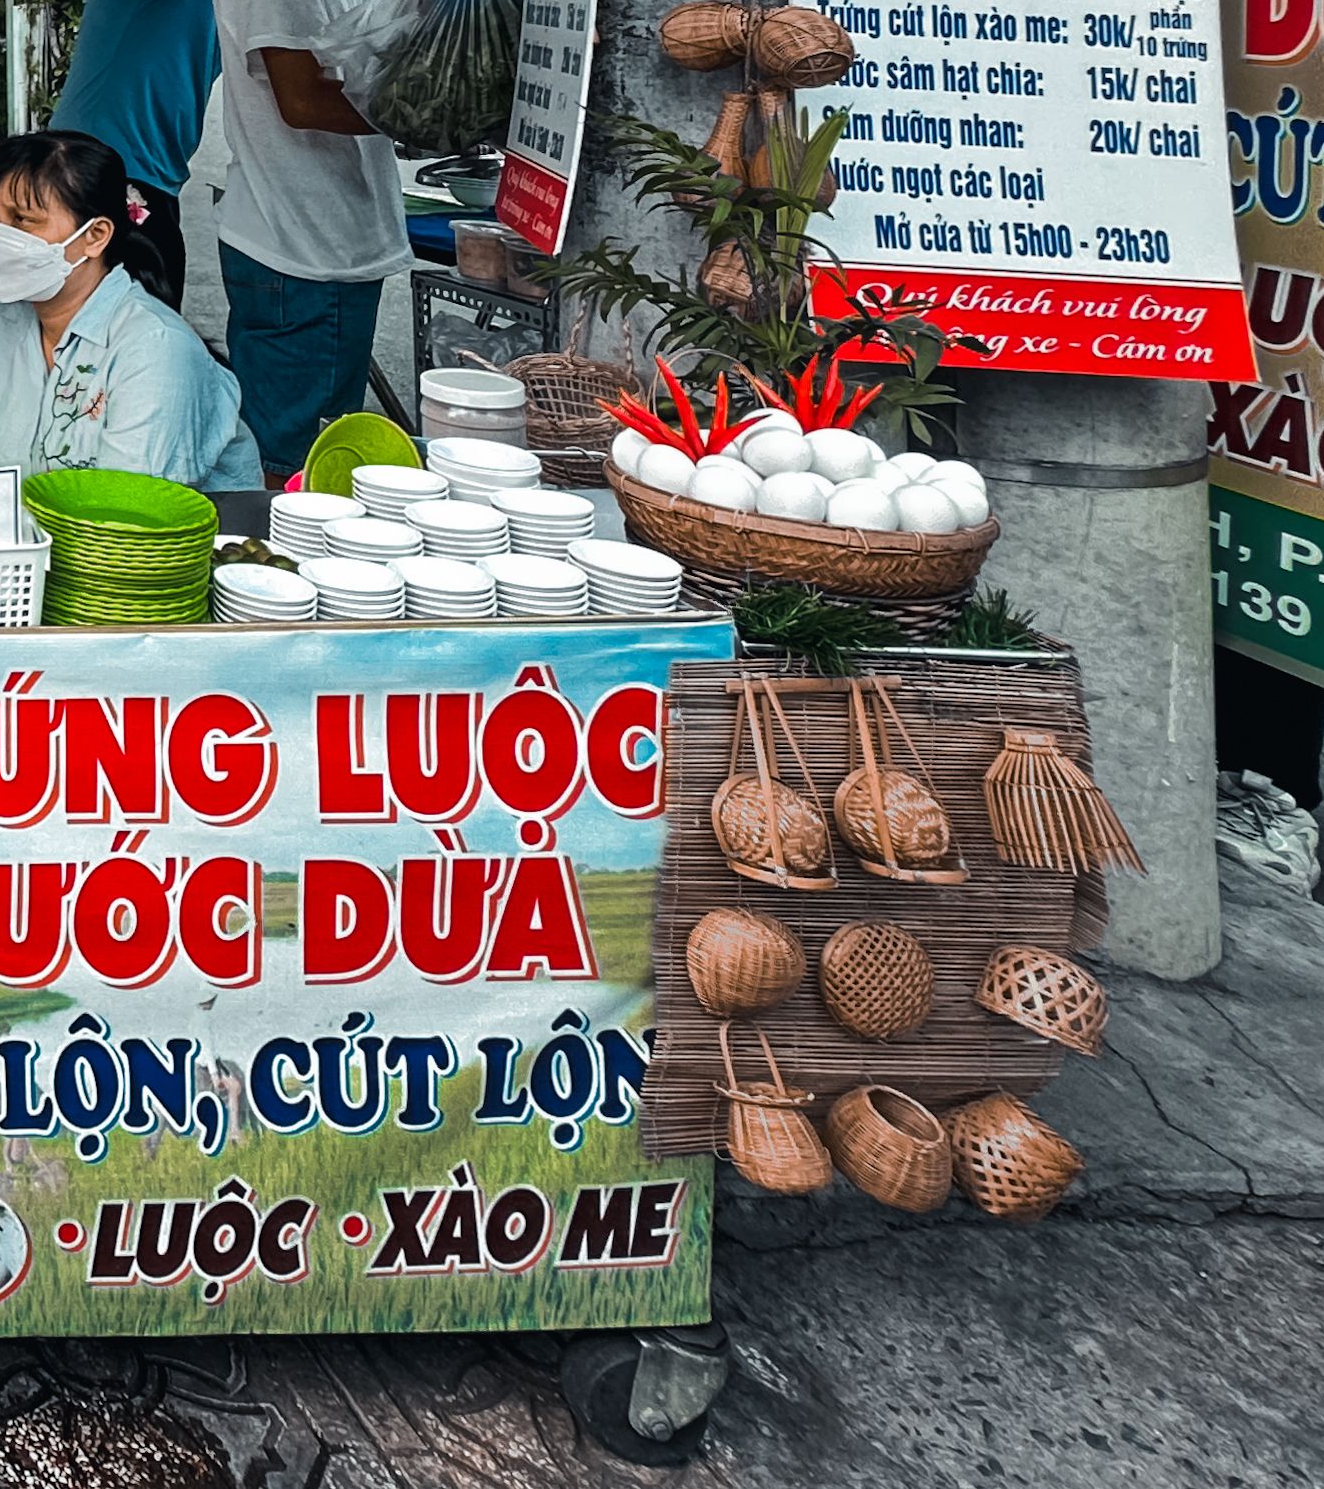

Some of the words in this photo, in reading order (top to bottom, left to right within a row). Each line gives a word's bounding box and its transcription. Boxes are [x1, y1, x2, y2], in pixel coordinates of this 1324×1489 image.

[816, 0, 881, 39] Trứng
[888, 1, 925, 37] cút
[931, 2, 968, 46] lộn
[976, 7, 1017, 43] xào
[1025, 14, 1068, 45] me:
[1084, 13, 1136, 49] 30k/
[1149, 5, 1193, 31] phần
[1136, 35, 1157, 57] 10
[1162, 35, 1208, 62] trứng
[887, 56, 935, 91] sâm
[943, 59, 979, 101] hạt
[987, 61, 1044, 97] chia:
[1087, 67, 1138, 102] 15k/
[1146, 69, 1196, 105] chai
[882, 109, 952, 150] dưỡng
[960, 114, 1024, 148] nhan:
[1090, 120, 1141, 155] 20k/
[1149, 121, 1201, 159] chai
[892, 164, 943, 203] ngọt
[950, 163, 992, 199] các
[1000, 166, 1045, 209] loại
[874, 212, 911, 251] Mở
[919, 214, 961, 253] cửa
[968, 216, 992, 255] từ
[999, 222, 1072, 259] 15h00
[1097, 227, 1171, 264] 23h30
[946, 283, 1052, 316] khách
[1063, 299, 1119, 319] vui
[1128, 293, 1208, 335] lòng
[1018, 336, 1060, 355] xe
[1091, 334, 1165, 361] Cám
[1174, 342, 1215, 364] ơn
[312, 661, 667, 852] LUỘC
[298, 825, 600, 985] DỪA
[248, 1011, 459, 1137] CÚT
[475, 1006, 657, 1153] LỘN
[85, 1176, 320, 1305] LUỘC
[364, 1161, 554, 1277] XÀO
[555, 1178, 689, 1272] ME
